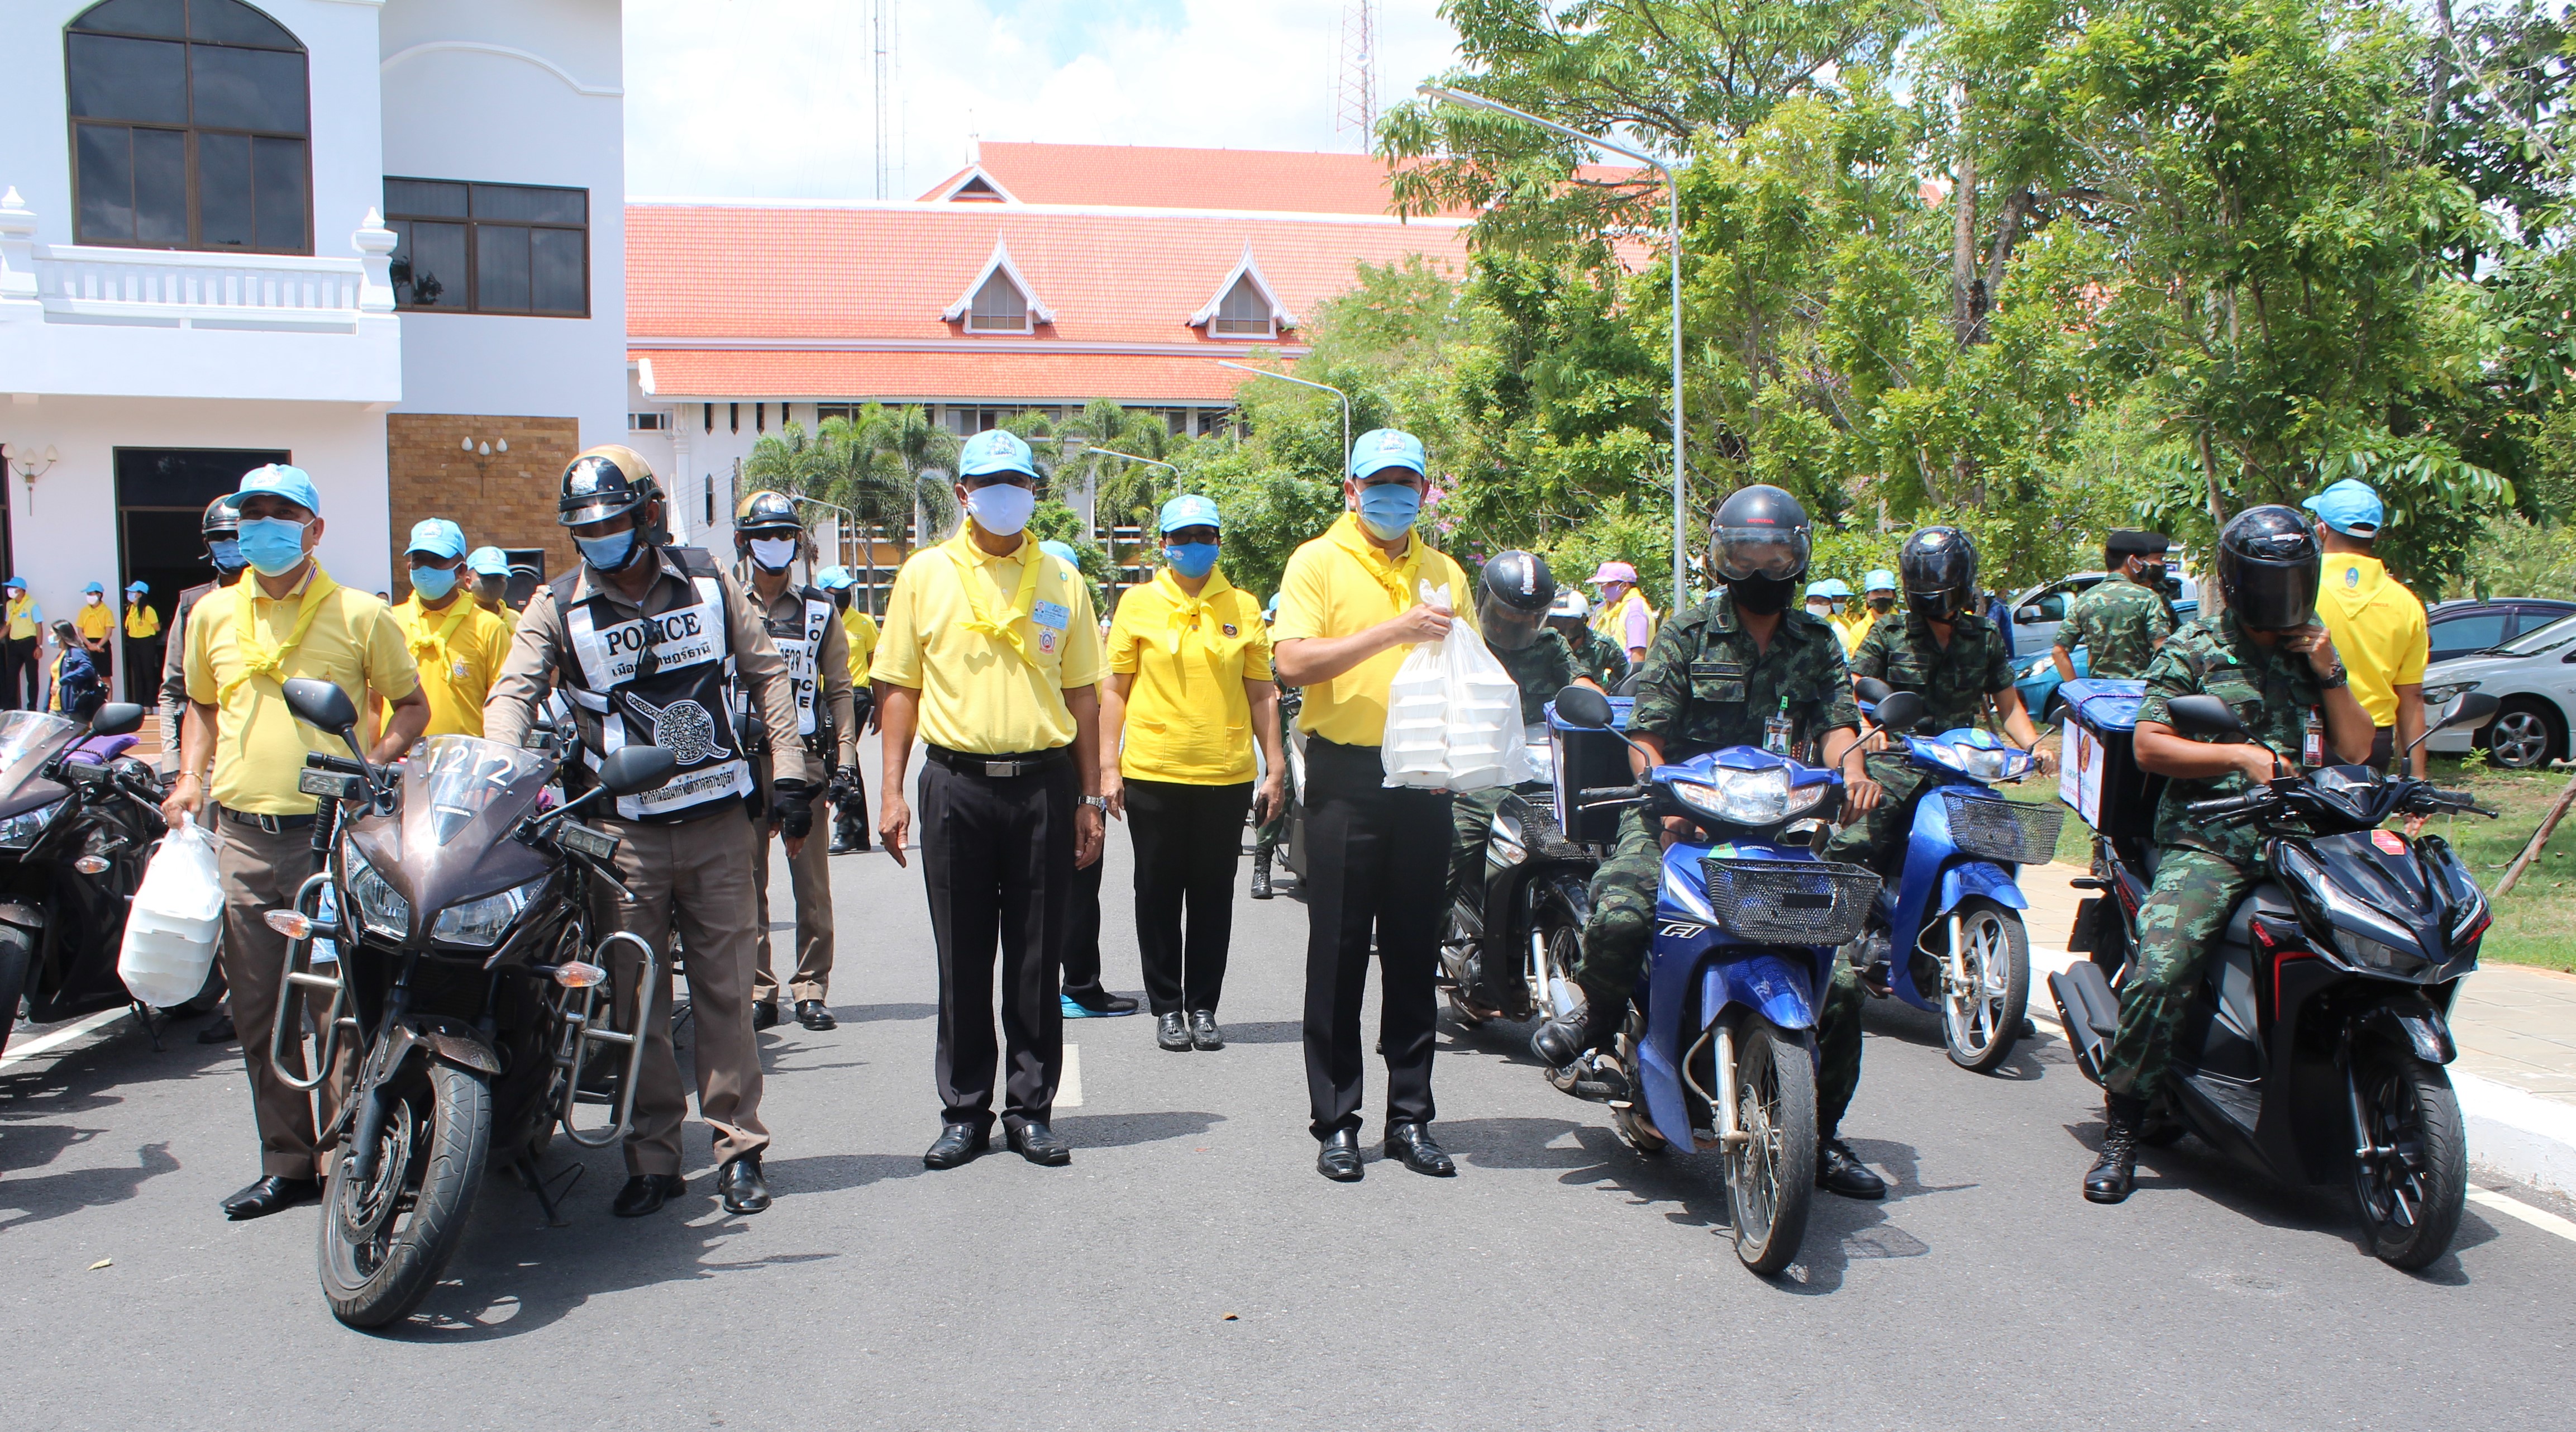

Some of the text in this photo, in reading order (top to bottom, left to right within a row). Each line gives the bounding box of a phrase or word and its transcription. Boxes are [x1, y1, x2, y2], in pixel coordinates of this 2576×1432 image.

[605, 612, 702, 656] POICE
[799, 613, 824, 708] POLICE
[427, 745, 513, 787] 1212
